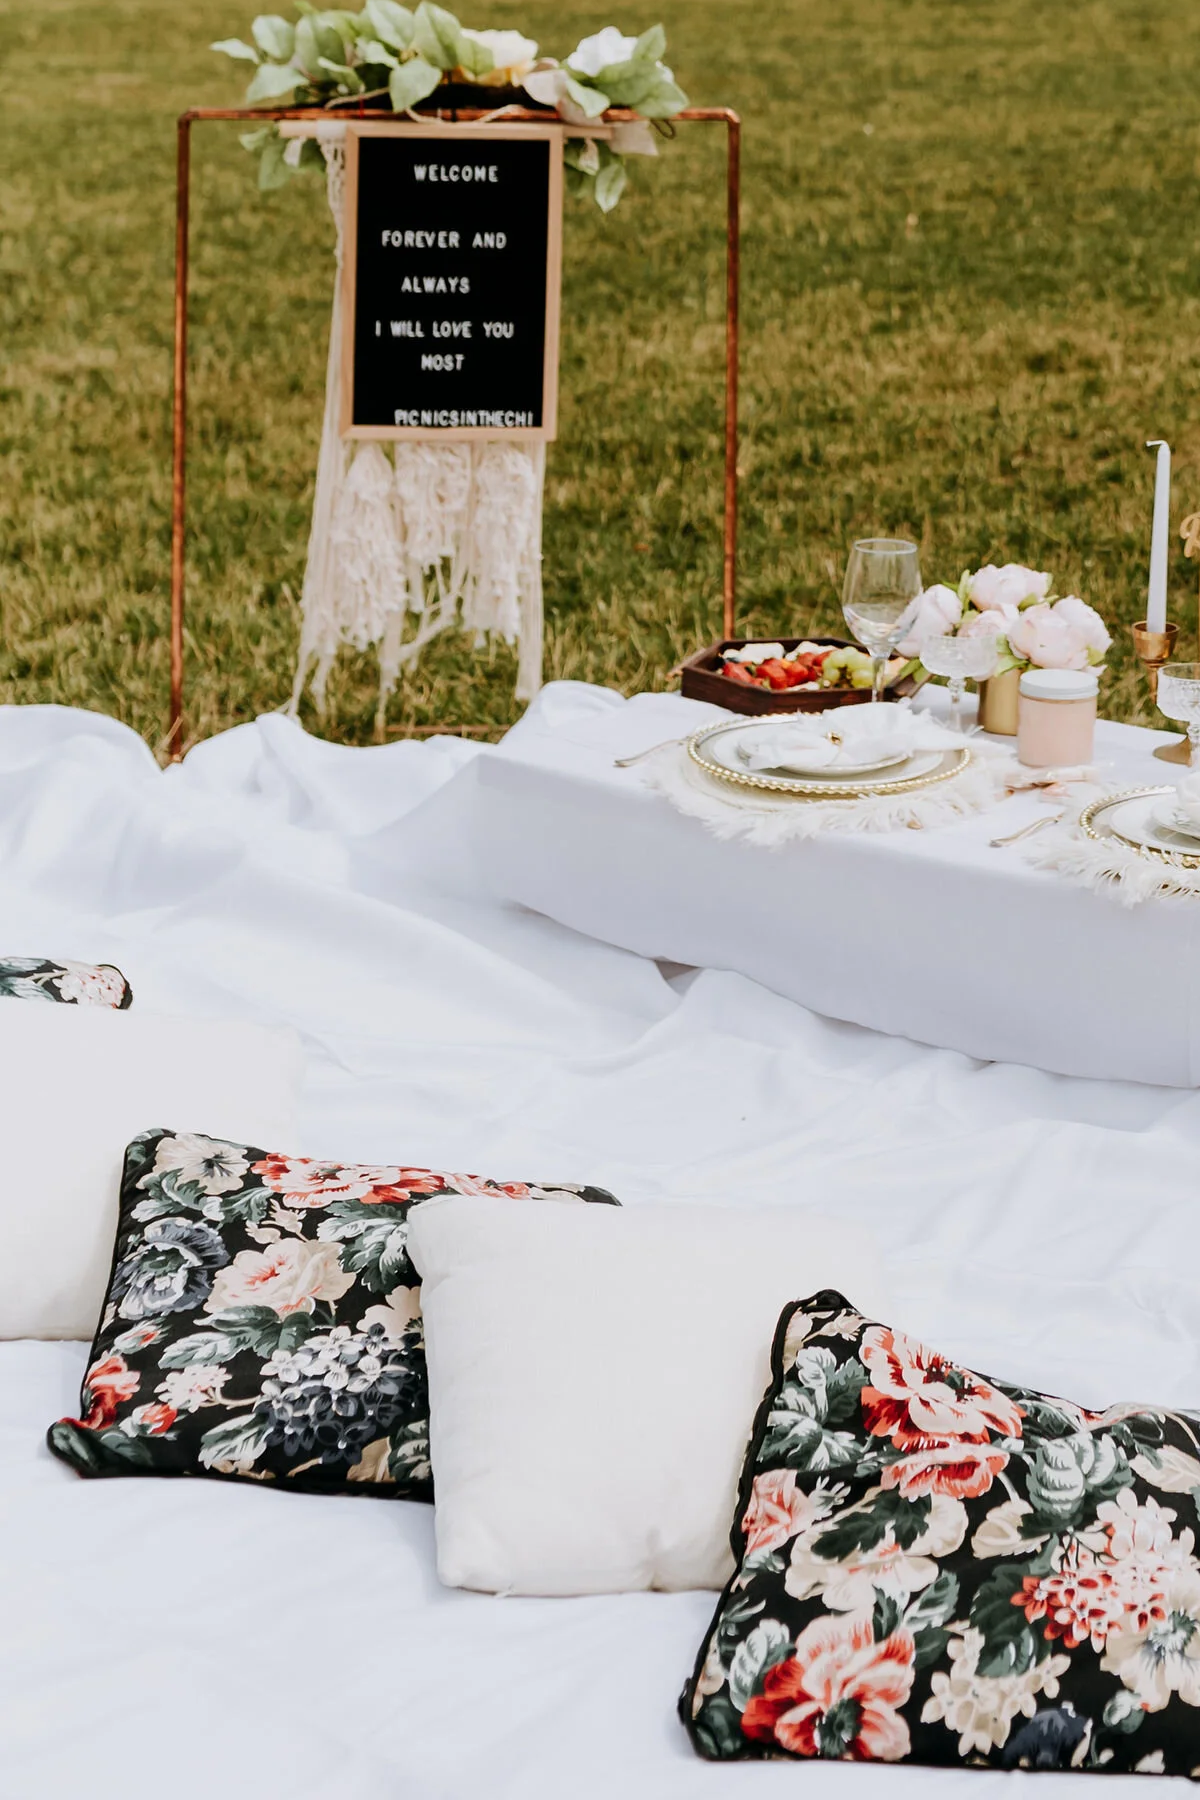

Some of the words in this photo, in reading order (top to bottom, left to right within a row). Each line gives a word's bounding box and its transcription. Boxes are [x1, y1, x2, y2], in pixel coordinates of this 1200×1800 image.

[414, 165, 498, 182] WELCOME
[382, 230, 459, 248] FOREVER
[473, 232, 506, 249] AND
[401, 277, 469, 293] ALWAYS
[376, 321, 381, 336] I
[390, 321, 424, 337] WILL
[433, 321, 471, 338] LOVE
[483, 322, 514, 338] YOU
[421, 354, 464, 371] MOST
